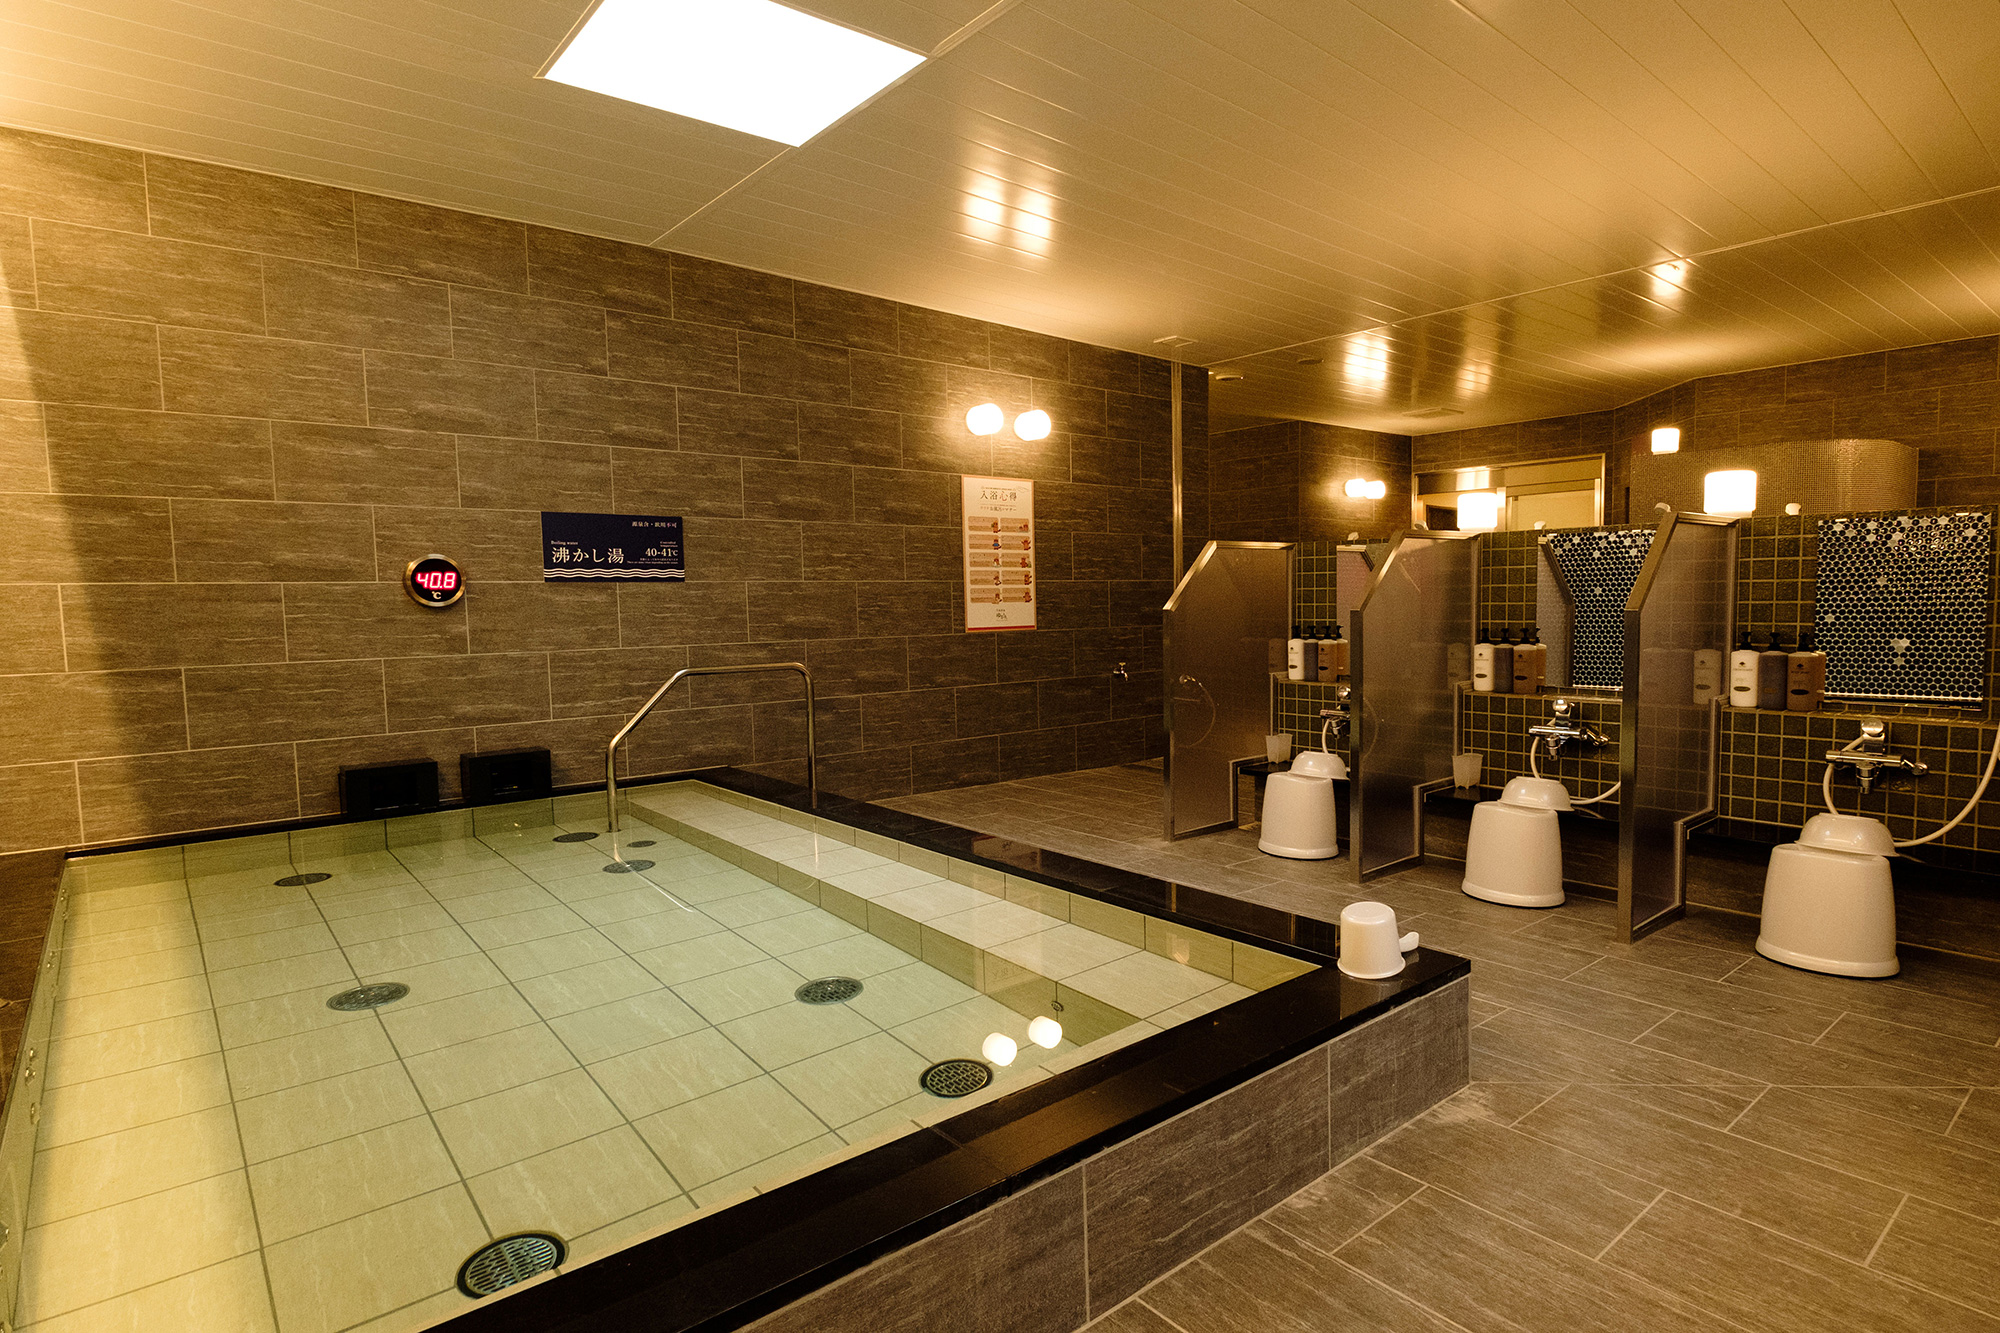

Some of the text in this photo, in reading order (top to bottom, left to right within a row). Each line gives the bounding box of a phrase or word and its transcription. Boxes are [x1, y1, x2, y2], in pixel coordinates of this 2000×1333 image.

[980, 490, 1017, 502] 入浴心得
[552, 546, 625, 564] 沸かし湯
[416, 571, 457, 589] 40.8
